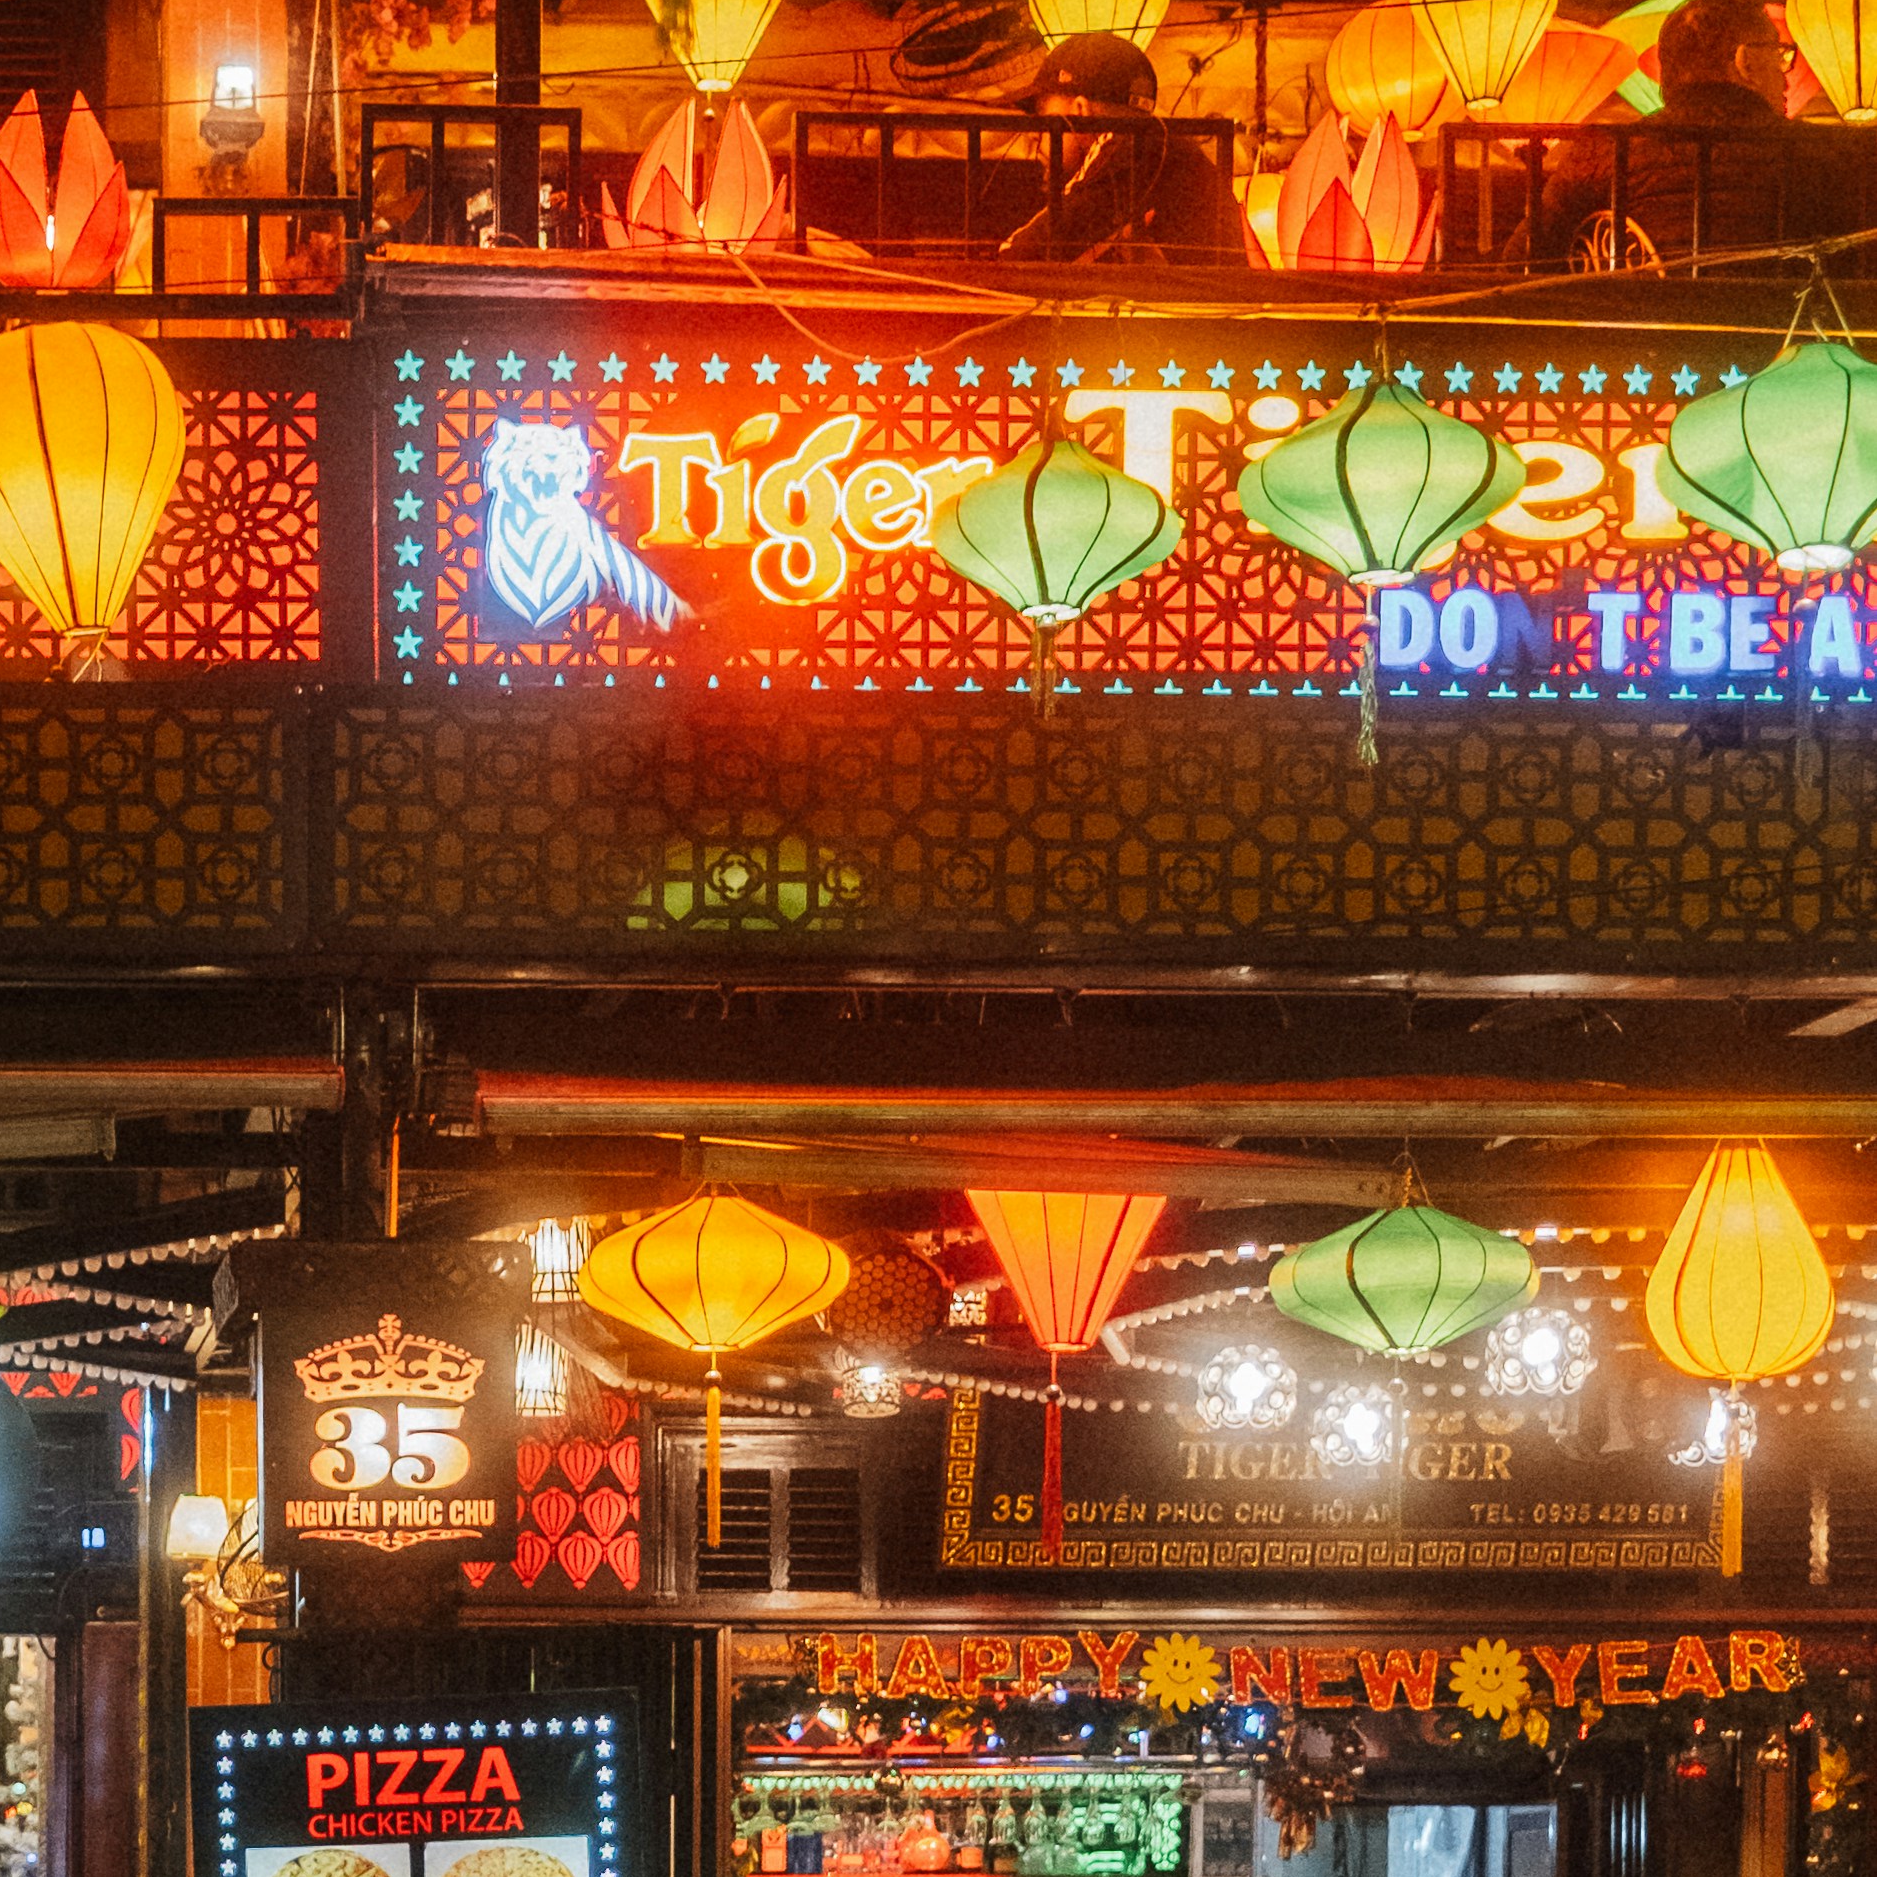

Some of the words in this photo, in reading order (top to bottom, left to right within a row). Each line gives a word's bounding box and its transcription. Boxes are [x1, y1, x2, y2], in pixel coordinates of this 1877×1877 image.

[620, 413, 994, 604] Tiger
[1670, 592, 1776, 674] BE
[1809, 594, 1862, 674] A
[309, 1403, 471, 1491] 35
[285, 1492, 377, 1527] NGUYỄN
[382, 1495, 443, 1527] PHÚC
[449, 1499, 495, 1526] CHU
[992, 1495, 1034, 1523] 35
[1235, 1502, 1285, 1524] CHU
[1469, 1503, 1525, 1524] TEL:
[818, 1631, 1139, 1700] HAPPY
[1229, 1645, 1439, 1710] NEW
[1532, 1630, 1792, 1709] YEAR
[306, 1746, 521, 1809] PIZZA
[308, 1810, 432, 1839] CHICKEN
[441, 1806, 524, 1833] PIZZA
